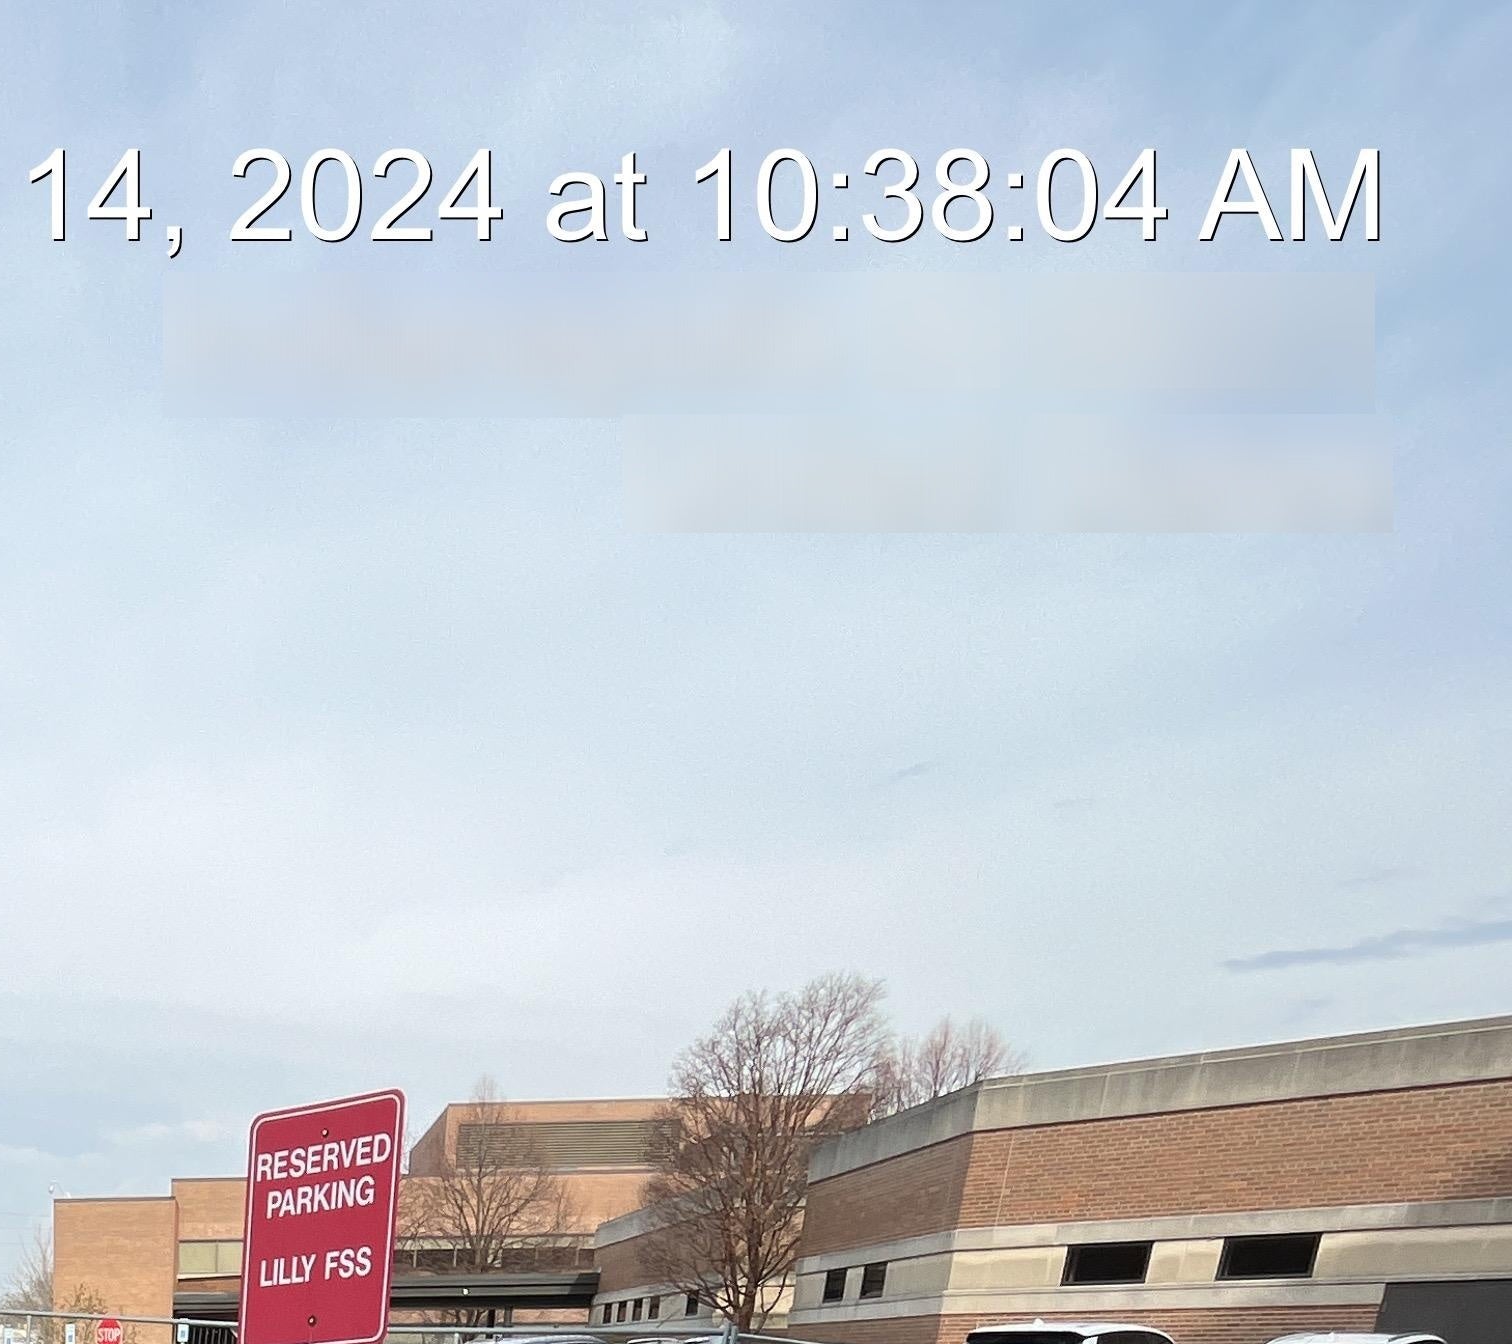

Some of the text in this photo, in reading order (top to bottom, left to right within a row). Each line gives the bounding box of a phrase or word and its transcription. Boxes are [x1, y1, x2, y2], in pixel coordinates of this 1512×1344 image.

[256, 1133, 391, 1182] RESERVED
[266, 1175, 375, 1219] PARKING
[260, 1247, 372, 1287] LILLY FSS
[98, 1327, 120, 1341] STOP
